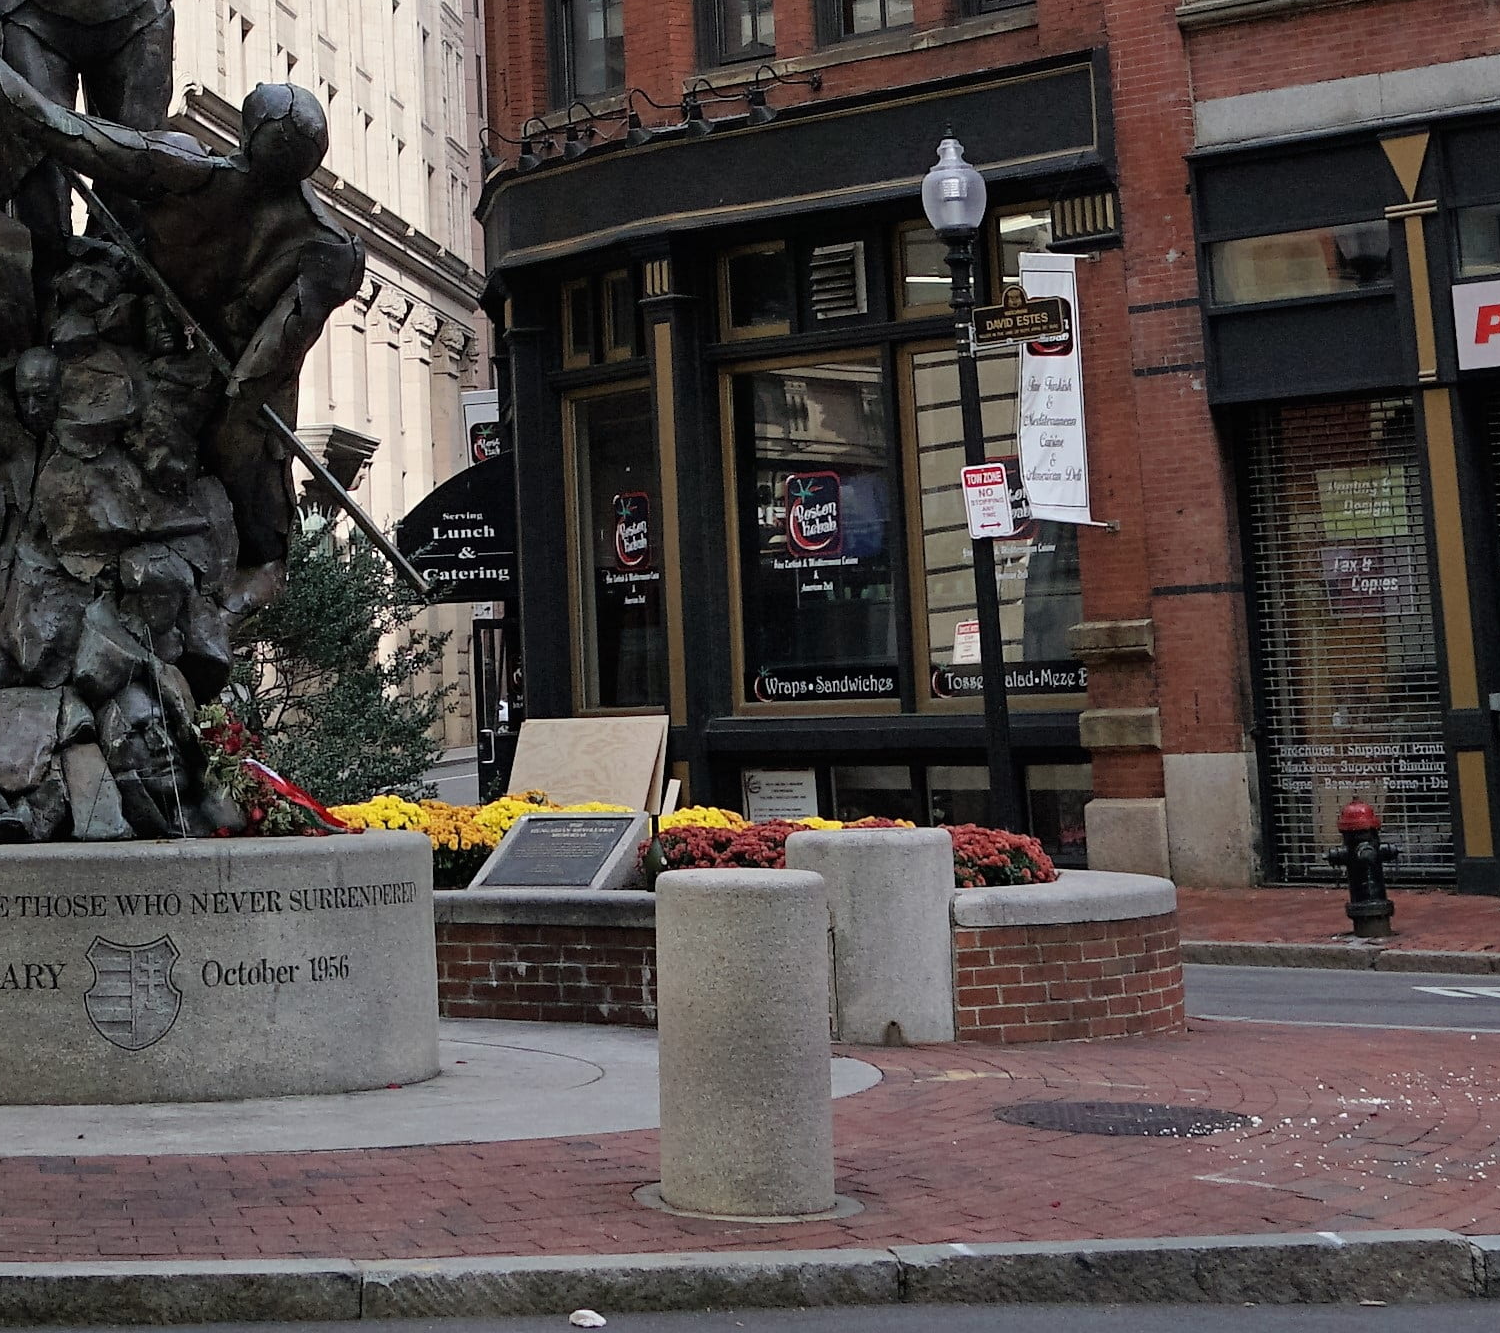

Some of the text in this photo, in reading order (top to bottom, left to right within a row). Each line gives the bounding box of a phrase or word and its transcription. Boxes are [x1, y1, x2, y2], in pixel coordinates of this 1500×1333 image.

[985, 317, 1014, 331] DAVID
[1016, 312, 1049, 327] ESTES
[966, 470, 1003, 486] TOW ZONE
[978, 487, 994, 498] NO
[442, 511, 484, 521] Serving
[432, 525, 496, 540] Lunch
[457, 546, 477, 560] &
[422, 566, 511, 582] Catering
[1351, 574, 1399, 595] Copies
[764, 674, 894, 695] Wraps Sandwiches
[944, 672, 984, 691] Tosse
[1004, 669, 1034, 688] alad
[1041, 667, 1076, 688] Meze
[15, 894, 108, 918] THOSE
[116, 892, 181, 917] WHO
[189, 889, 283, 916] NEVER
[289, 881, 417, 913] SURRENDERED
[202, 959, 300, 988] October
[308, 954, 350, 983] 1956
